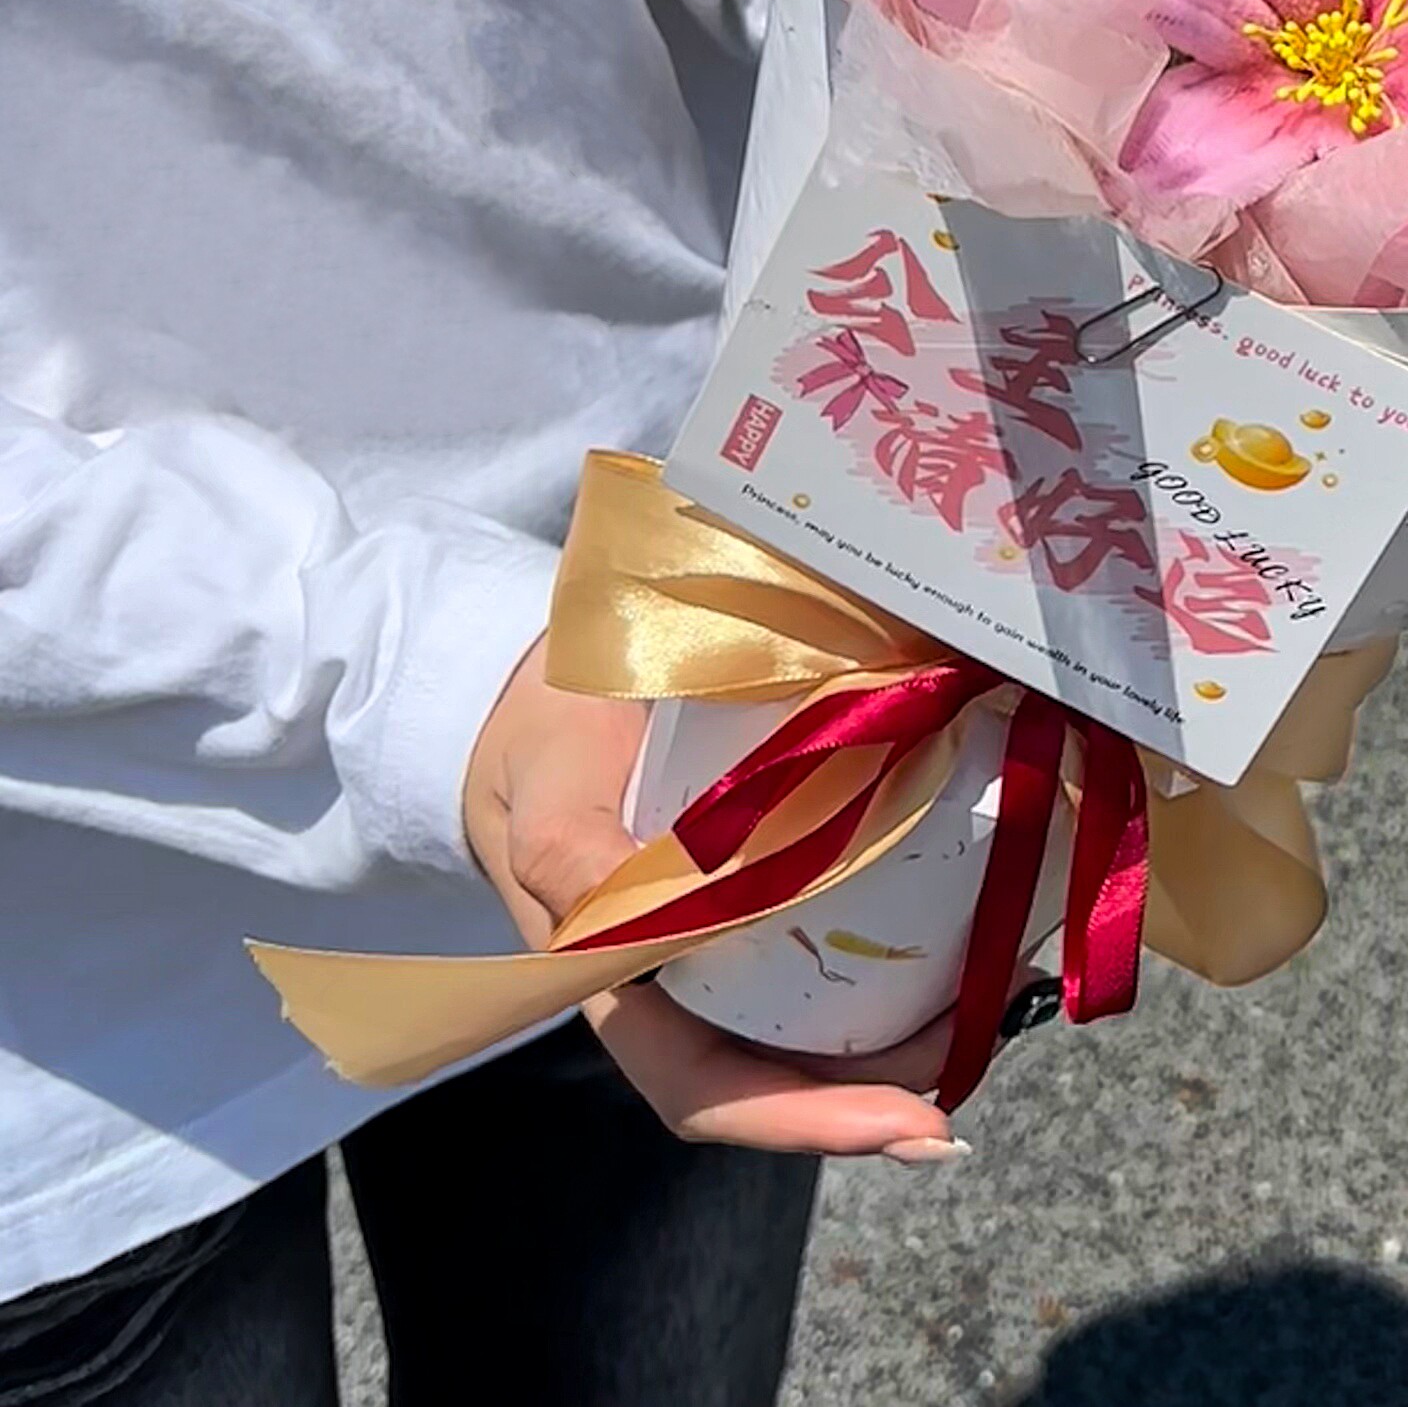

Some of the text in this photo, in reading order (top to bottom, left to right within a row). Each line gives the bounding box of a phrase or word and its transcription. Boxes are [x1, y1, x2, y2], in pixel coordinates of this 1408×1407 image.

[805, 229, 1083, 452] 公主
[1234, 336, 1296, 371] good
[1297, 359, 1342, 393] luck
[1350, 385, 1375, 409] to
[730, 397, 776, 469] HAPPY
[871, 399, 1277, 657] 请好运
[1130, 461, 1327, 620] GOOD LUCKY
[804, 520, 835, 543] may
[836, 542, 863, 558] you
[865, 552, 883, 568] be
[884, 562, 920, 590] lucky
[923, 585, 974, 617] enough
[977, 610, 993, 626] to
[995, 621, 1026, 644] gain
[1027, 639, 1072, 667] wealth
[1073, 660, 1089, 676] in
[1090, 671, 1122, 691] your
[1123, 685, 1164, 716] lovely
